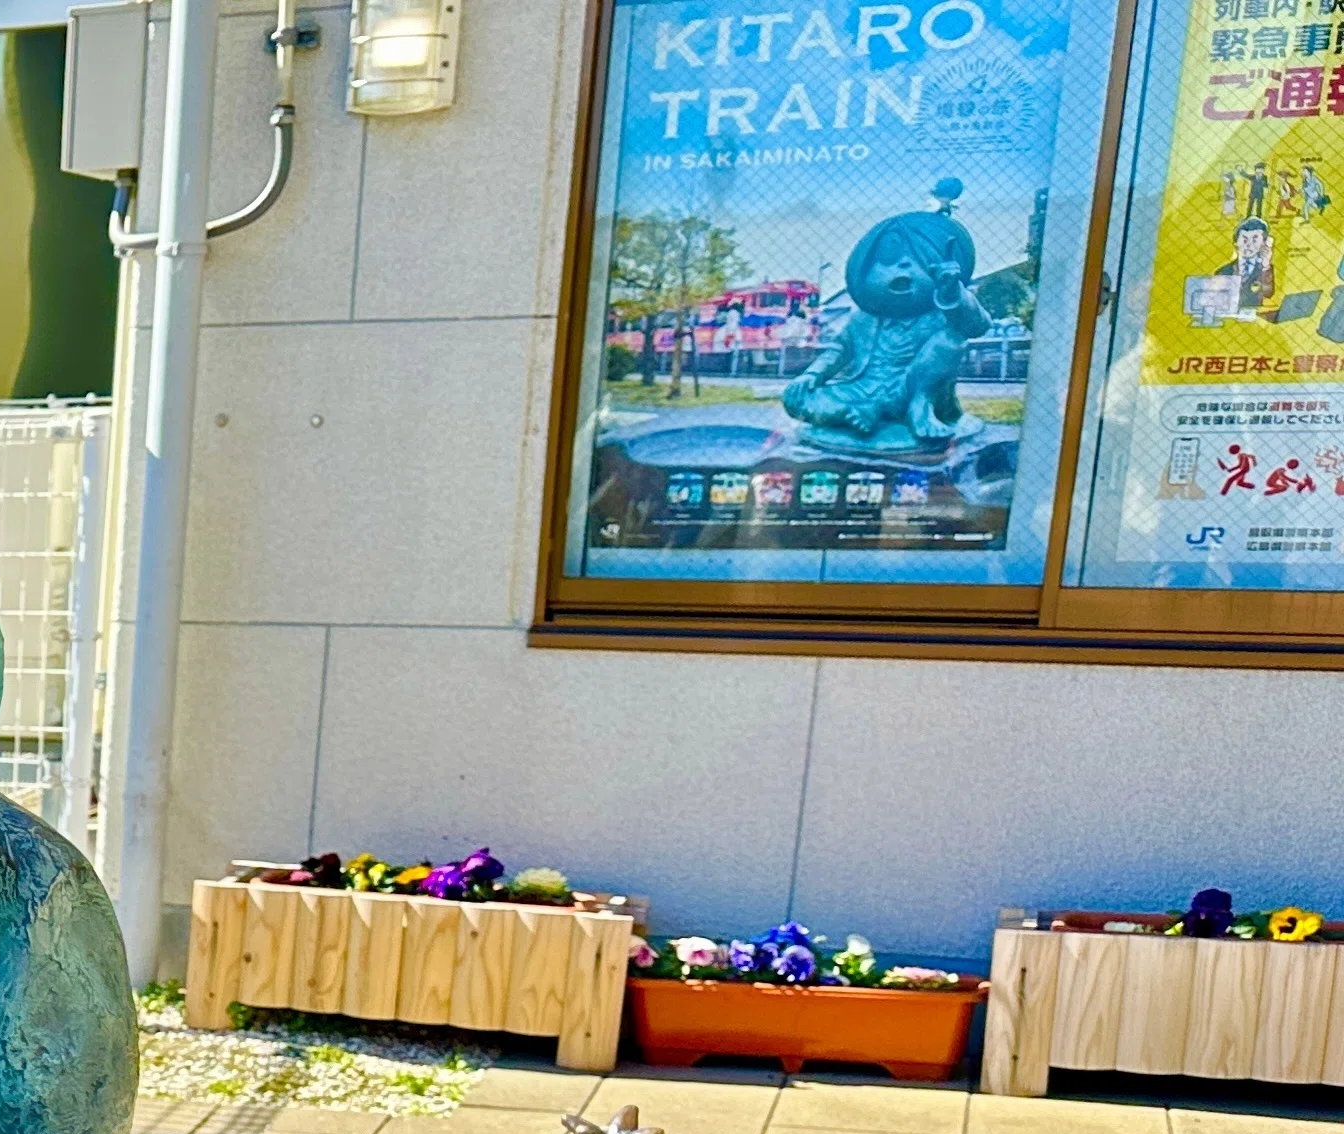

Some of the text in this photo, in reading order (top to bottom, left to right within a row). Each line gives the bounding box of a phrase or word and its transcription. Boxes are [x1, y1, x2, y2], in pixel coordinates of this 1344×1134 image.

[653, 0, 986, 70] KITARO
[1210, 23, 1344, 62] 緊急事
[649, 75, 923, 139] TRAIN
[644, 144, 871, 173] IN SAKAIMINATO
[1167, 354, 1344, 375] JR西日本と警察
[1186, 526, 1225, 545] JR
